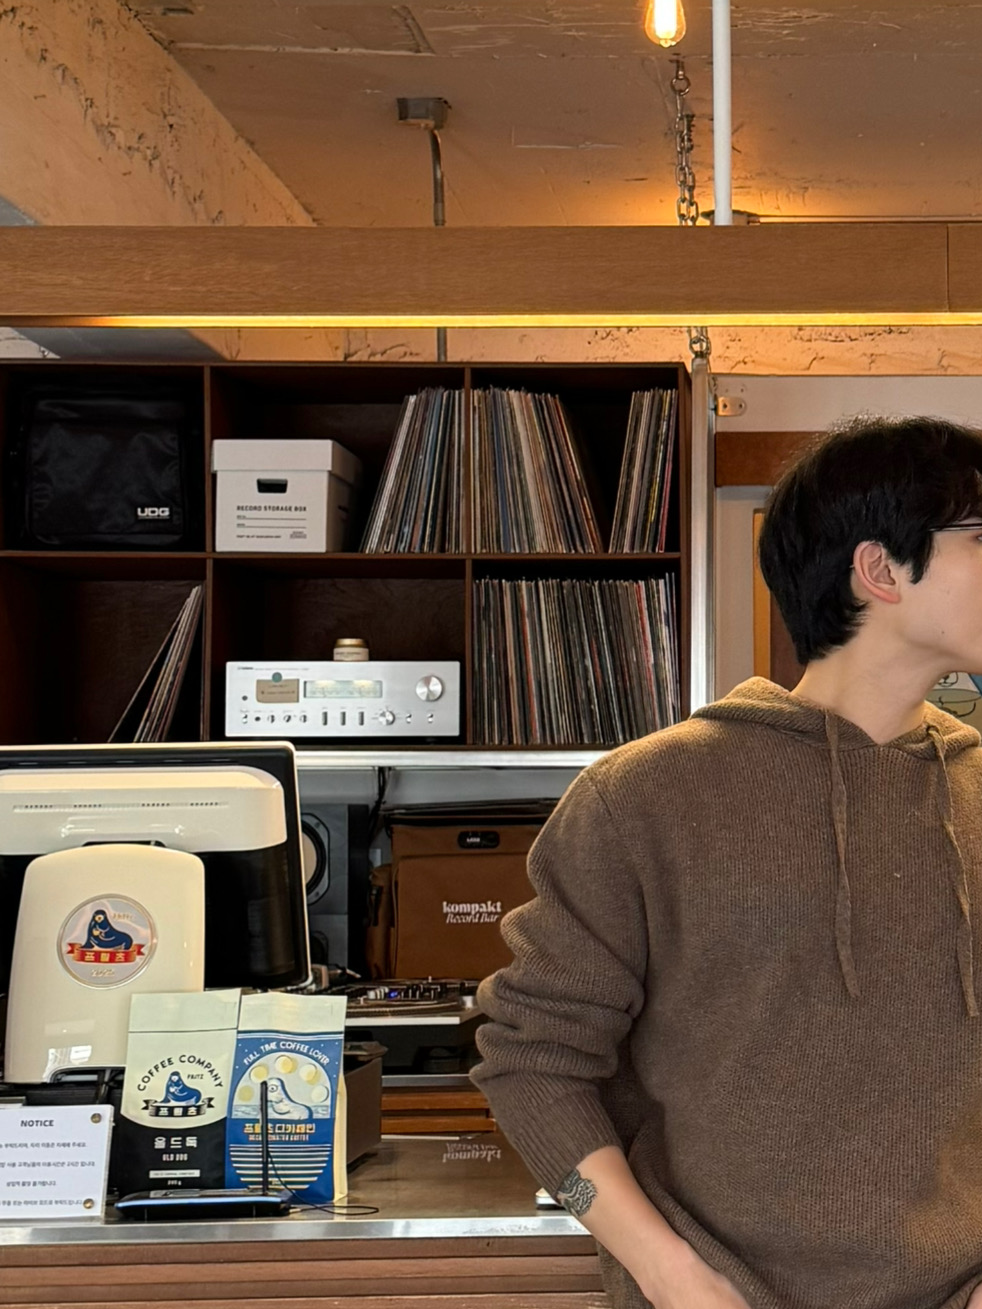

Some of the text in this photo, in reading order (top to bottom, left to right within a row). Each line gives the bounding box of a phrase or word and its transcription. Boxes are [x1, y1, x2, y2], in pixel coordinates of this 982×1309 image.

[137, 507, 170, 517] UDG
[442, 901, 502, 915] kompakt
[446, 913, 499, 924] Record Bar
[243, 1041, 330, 1066] FULL TIME COFFEE LOVER
[137, 1054, 224, 1092] COFFEE COMPANY
[20, 1119, 55, 1127] NOTICE
[154, 1136, 198, 1149] 올드독
